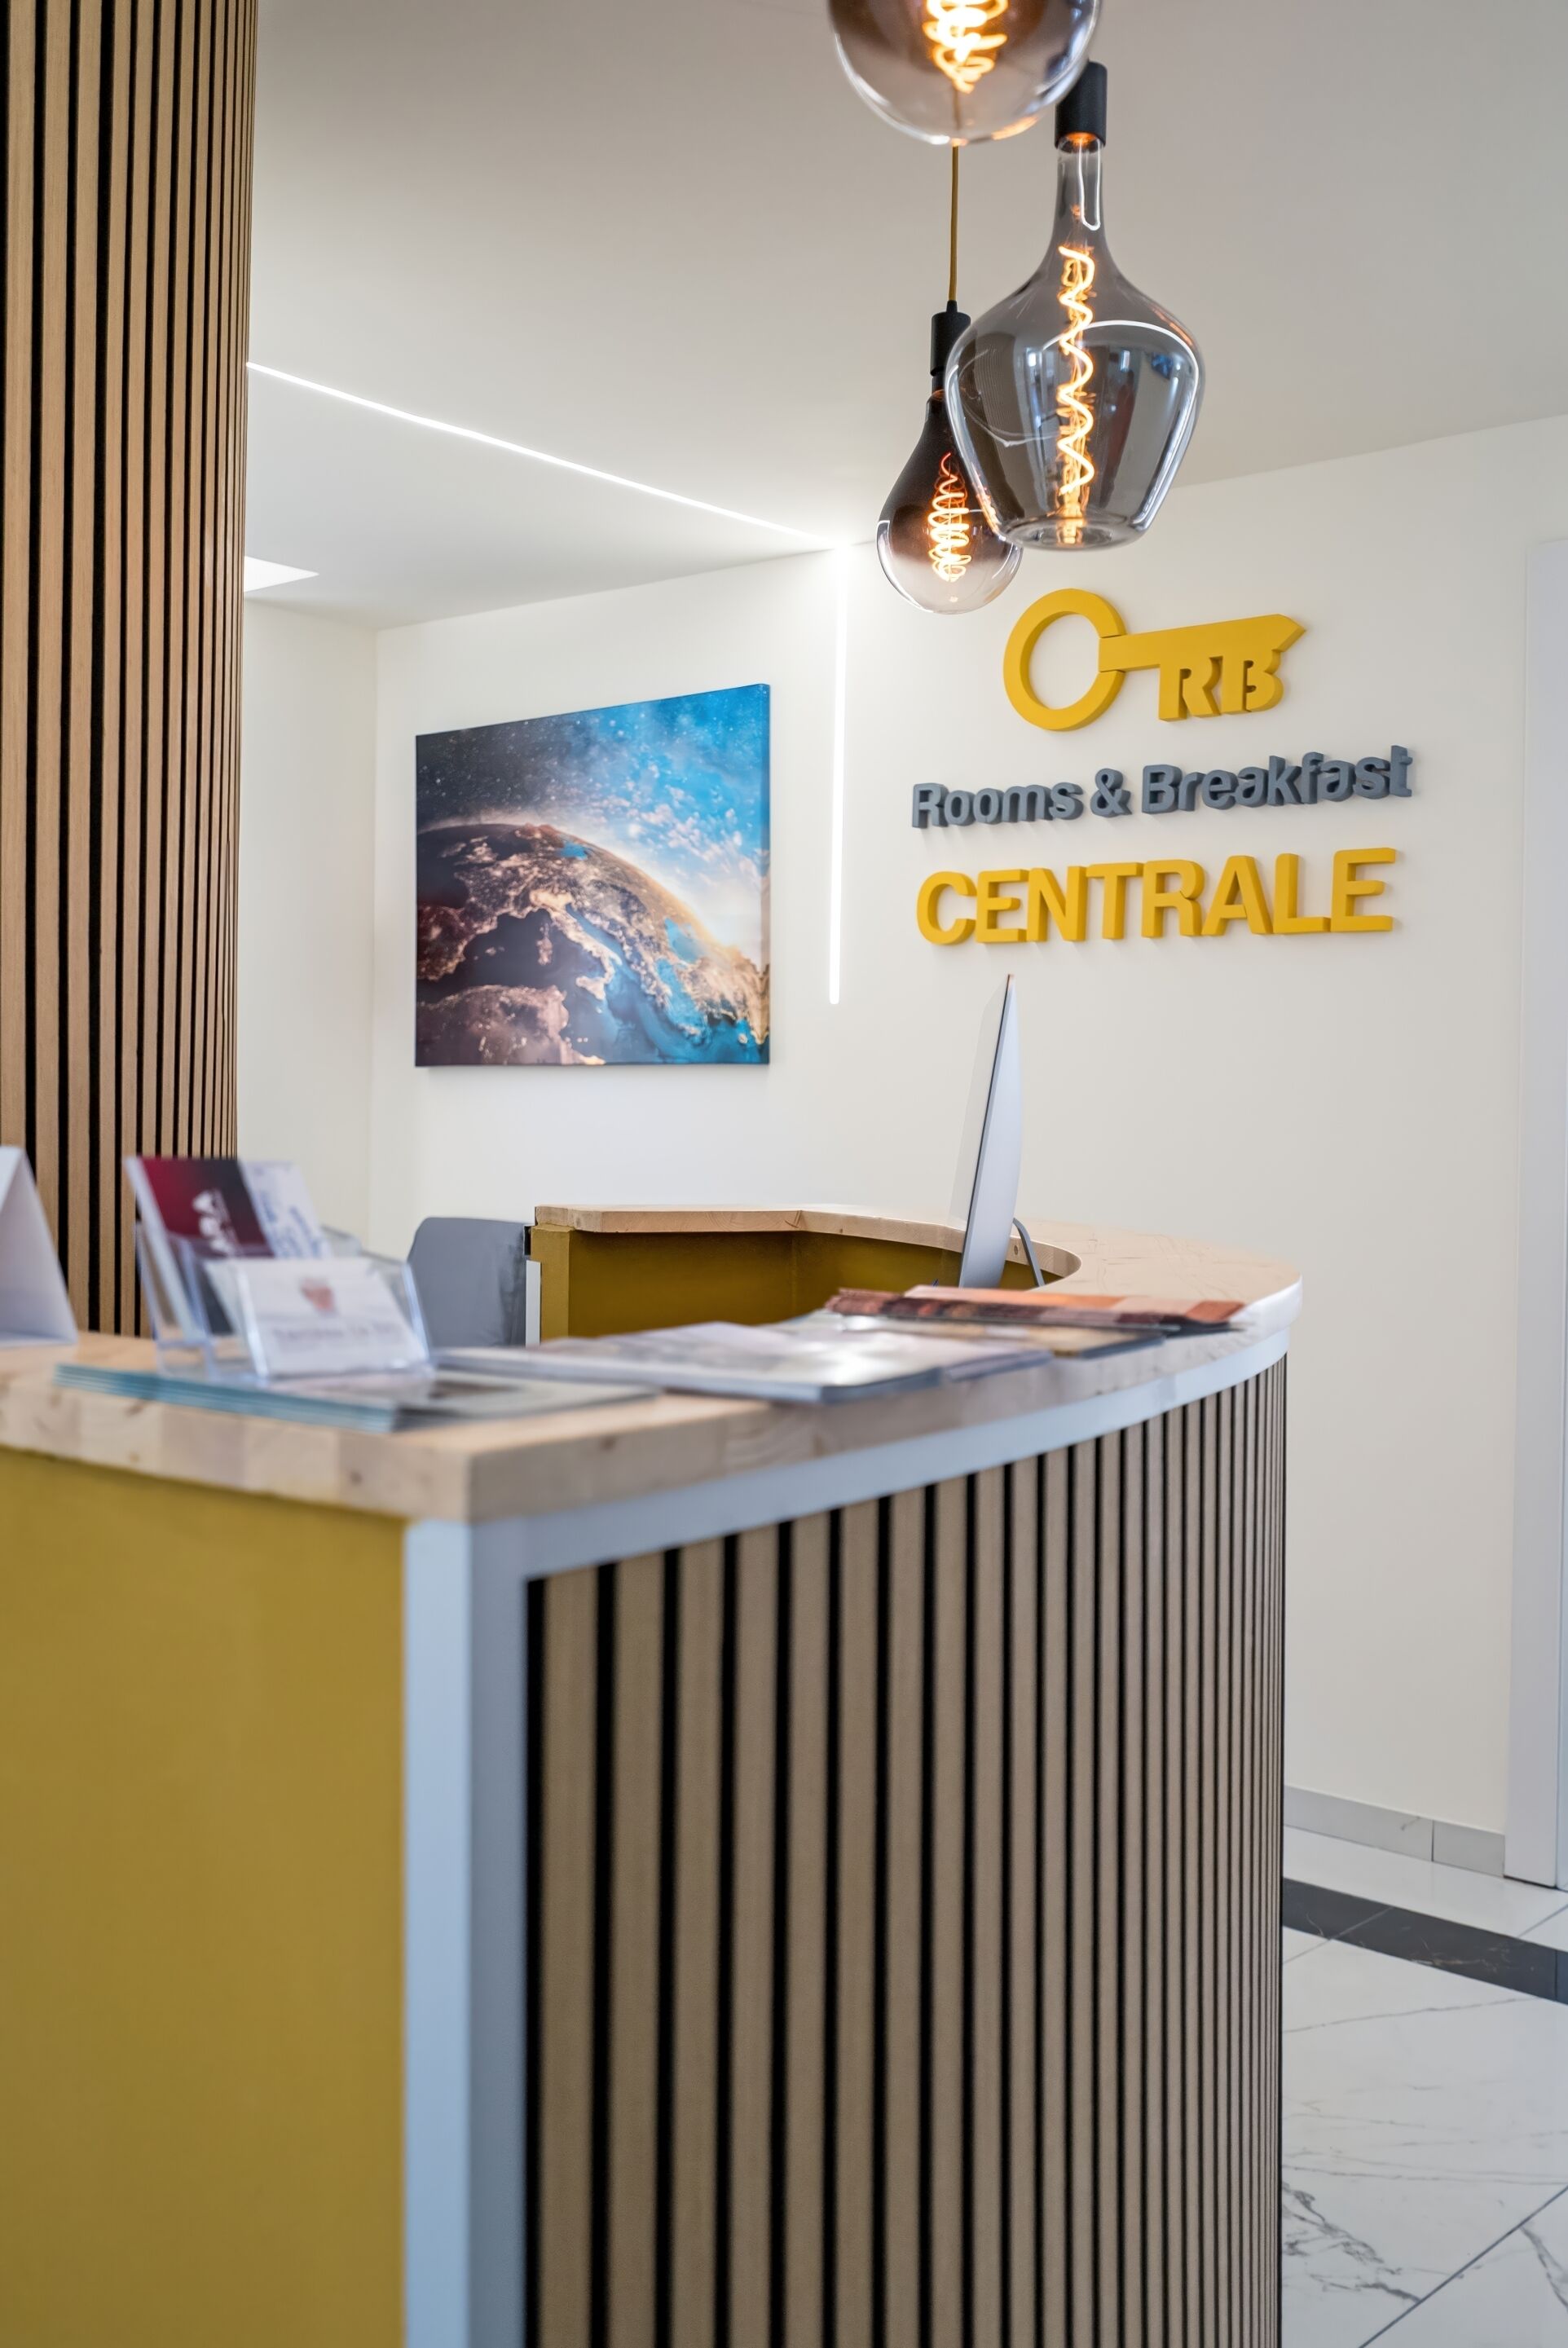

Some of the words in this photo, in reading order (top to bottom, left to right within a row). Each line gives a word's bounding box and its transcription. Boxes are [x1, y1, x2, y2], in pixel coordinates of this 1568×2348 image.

[1158, 650, 1284, 721] RB
[912, 782, 1084, 829] Rooms
[1090, 768, 1132, 817] &
[1142, 745, 1413, 814] Breakfast
[916, 848, 1397, 945] CENTRALE
